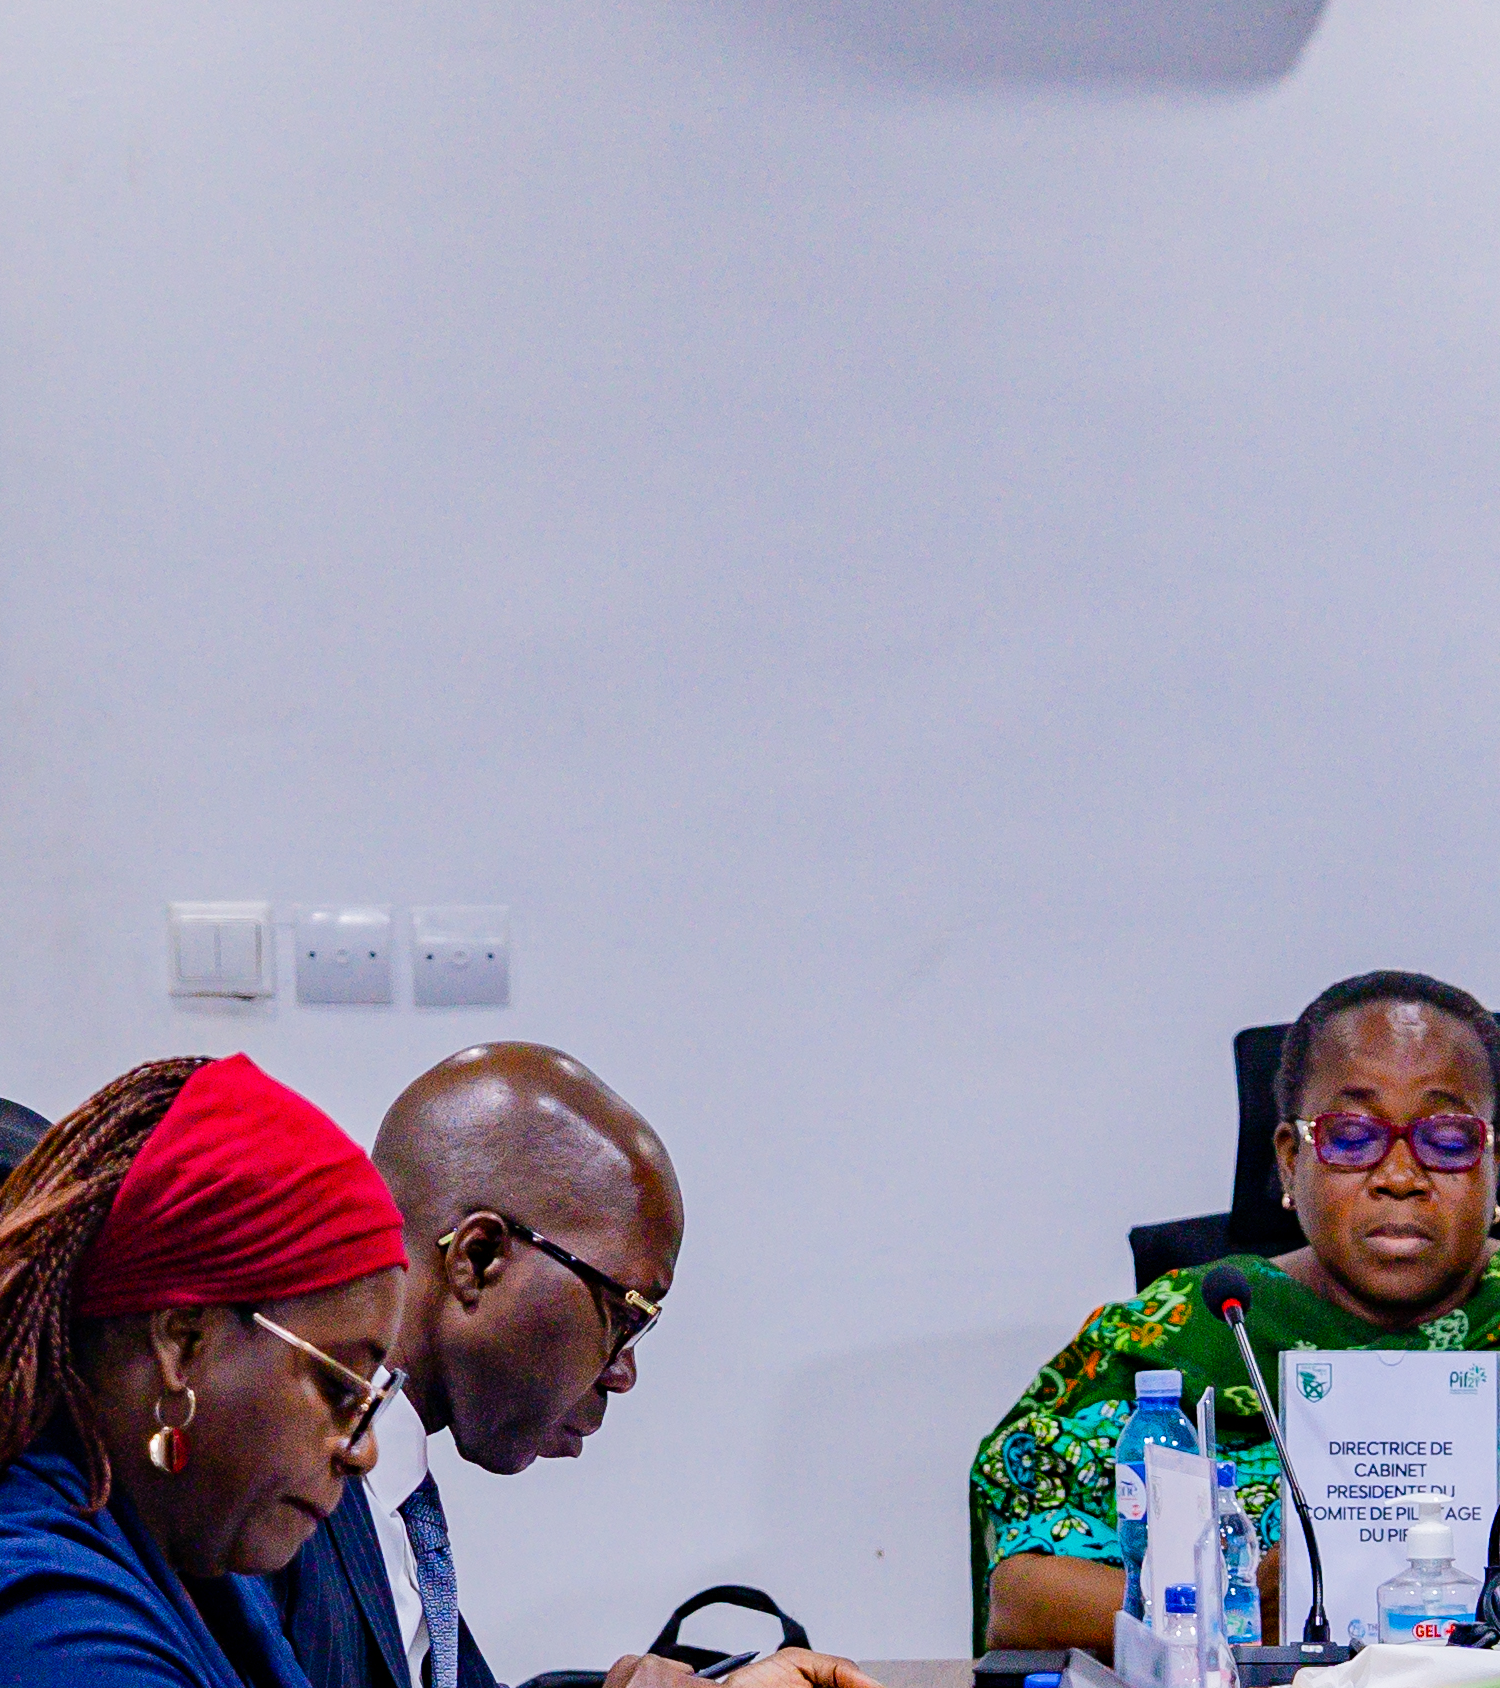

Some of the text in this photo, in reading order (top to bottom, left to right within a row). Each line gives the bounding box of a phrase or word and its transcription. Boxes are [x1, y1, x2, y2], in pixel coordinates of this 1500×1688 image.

[1329, 1441, 1453, 1456] DIRECTRICE DE
[1354, 1463, 1427, 1478] CABINET
[1327, 1485, 1427, 1499] PRESIDENTE
[1370, 1506, 1392, 1521] DE
[1396, 1506, 1482, 1521] PILAGE
[1360, 1528, 1385, 1543] DU
[1415, 1624, 1442, 1638] GEL
